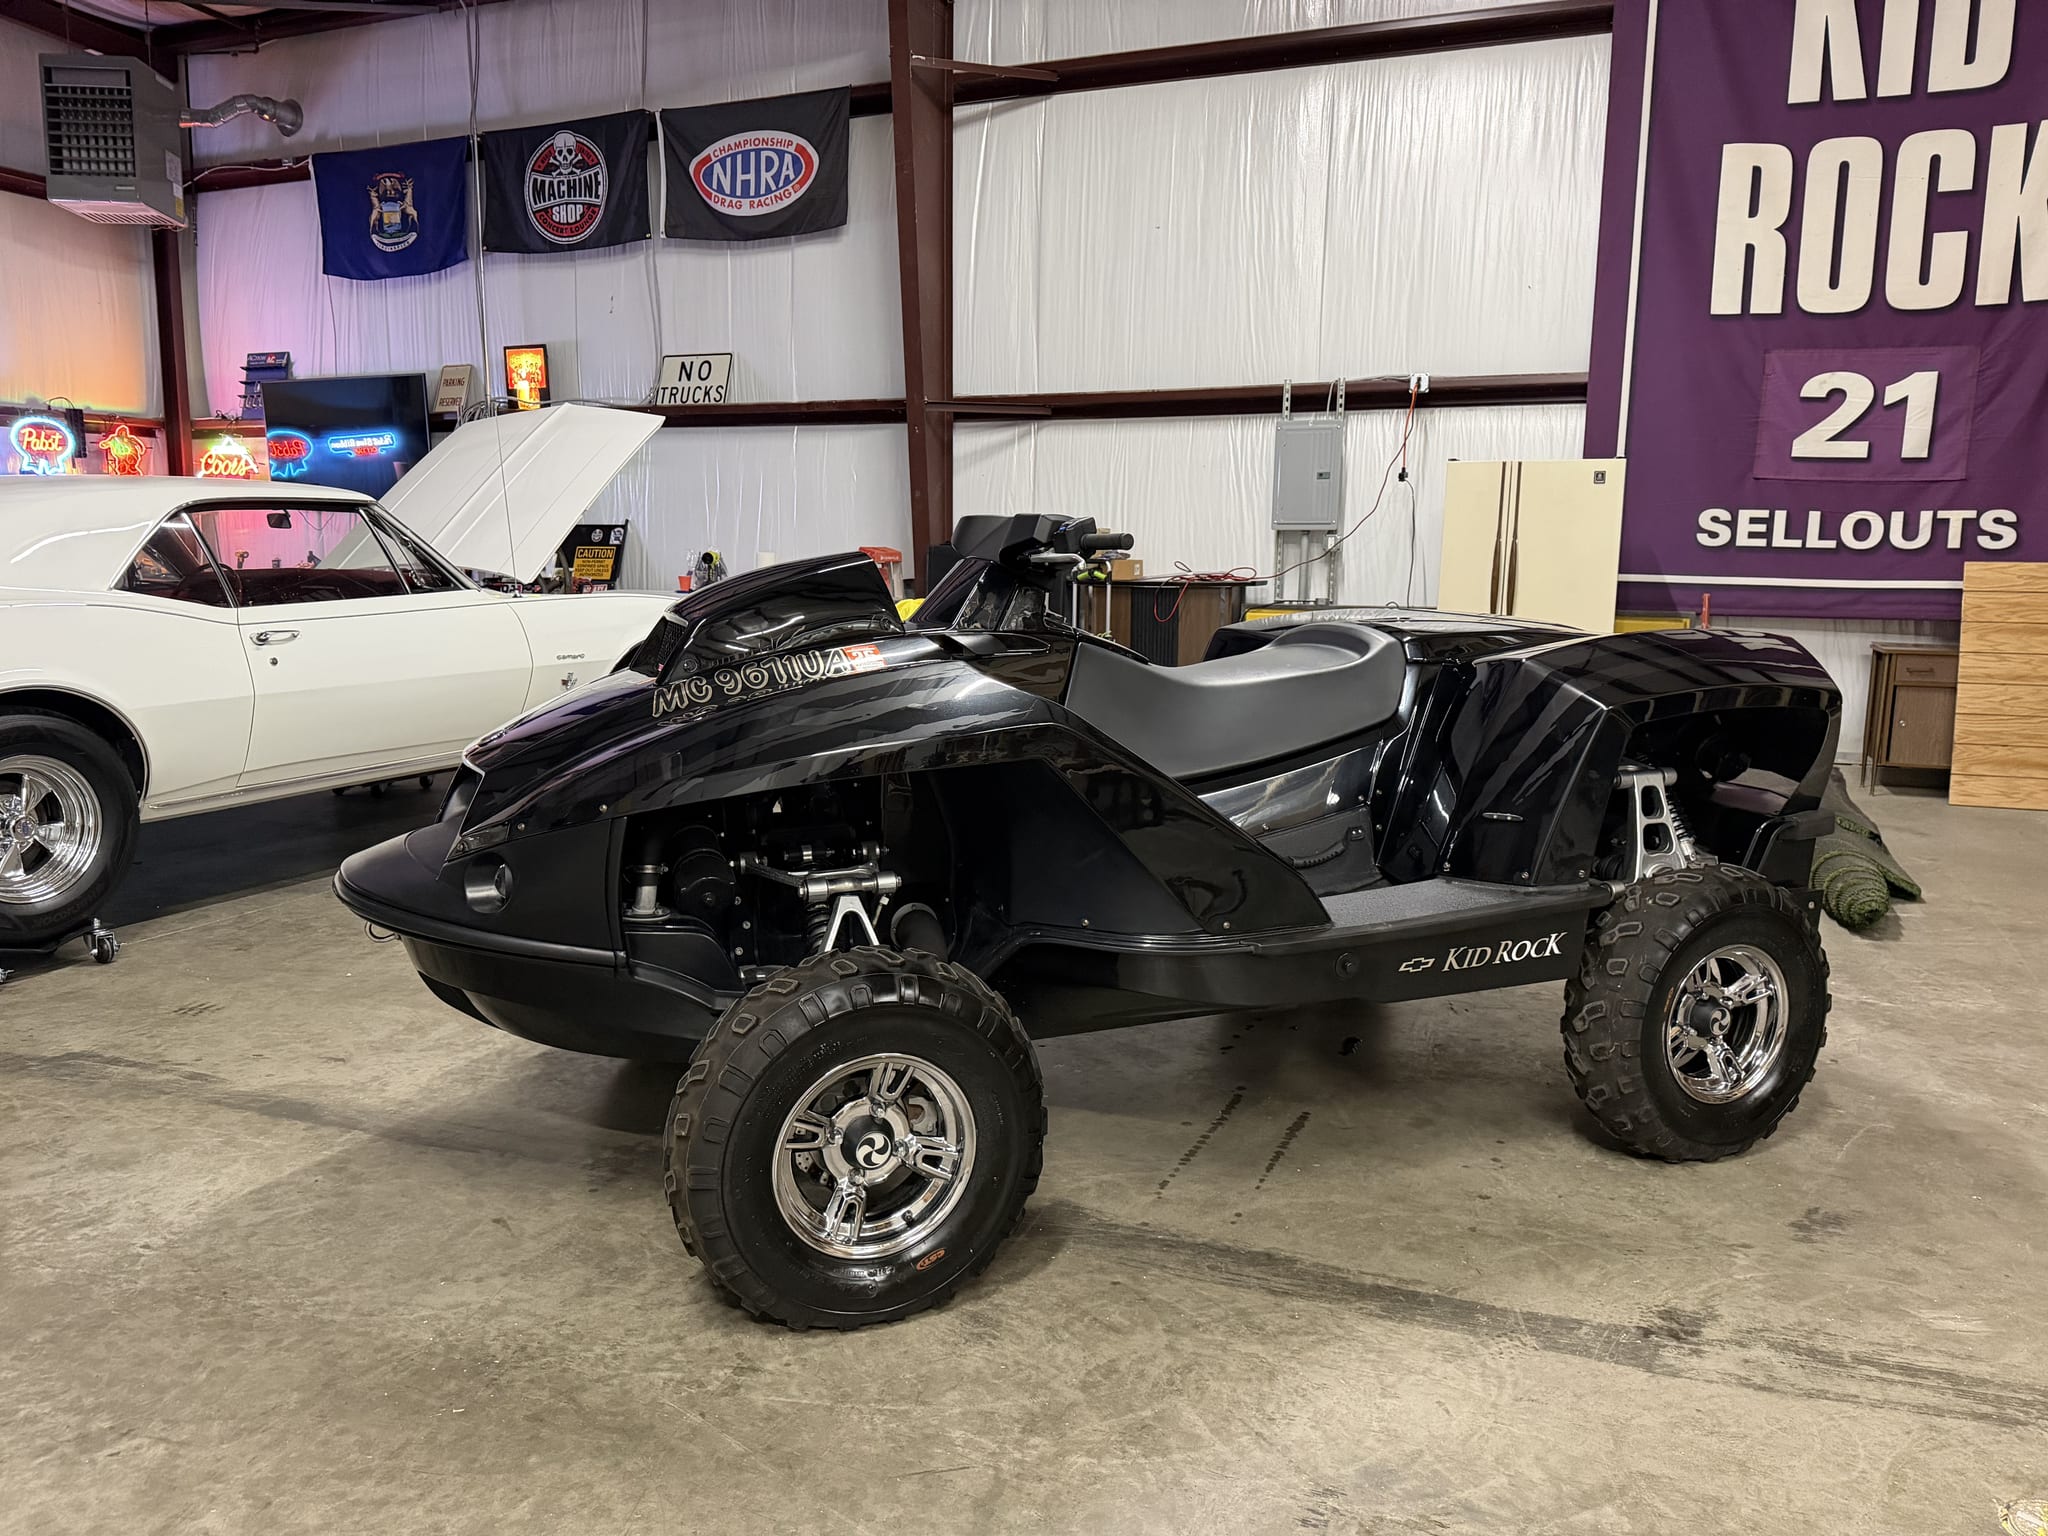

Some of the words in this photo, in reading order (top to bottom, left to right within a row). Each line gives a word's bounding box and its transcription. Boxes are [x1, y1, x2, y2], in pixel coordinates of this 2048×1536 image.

[1787, 0, 2016, 104] KID
[712, 137, 794, 158] CHAMPIONSHIP
[531, 171, 601, 206] MACHINE
[711, 150, 796, 197] NHRA
[552, 204, 584, 223] SHOP
[713, 194, 743, 210] DRAG
[748, 187, 792, 209] RACING
[1710, 119, 2048, 315] ROCK
[678, 360, 712, 382] NO
[660, 385, 724, 404] TRUCKS
[1791, 370, 1939, 459] 21
[20, 427, 63, 452] Pabst
[201, 450, 250, 477] Coors
[1696, 508, 2018, 551] SELLOUTS
[577, 548, 614, 558] CAUTION
[652, 675, 713, 718] MC
[714, 647, 851, 697] 9671UA
[1441, 946, 1492, 972] KID
[1492, 931, 1568, 965] ROCK
